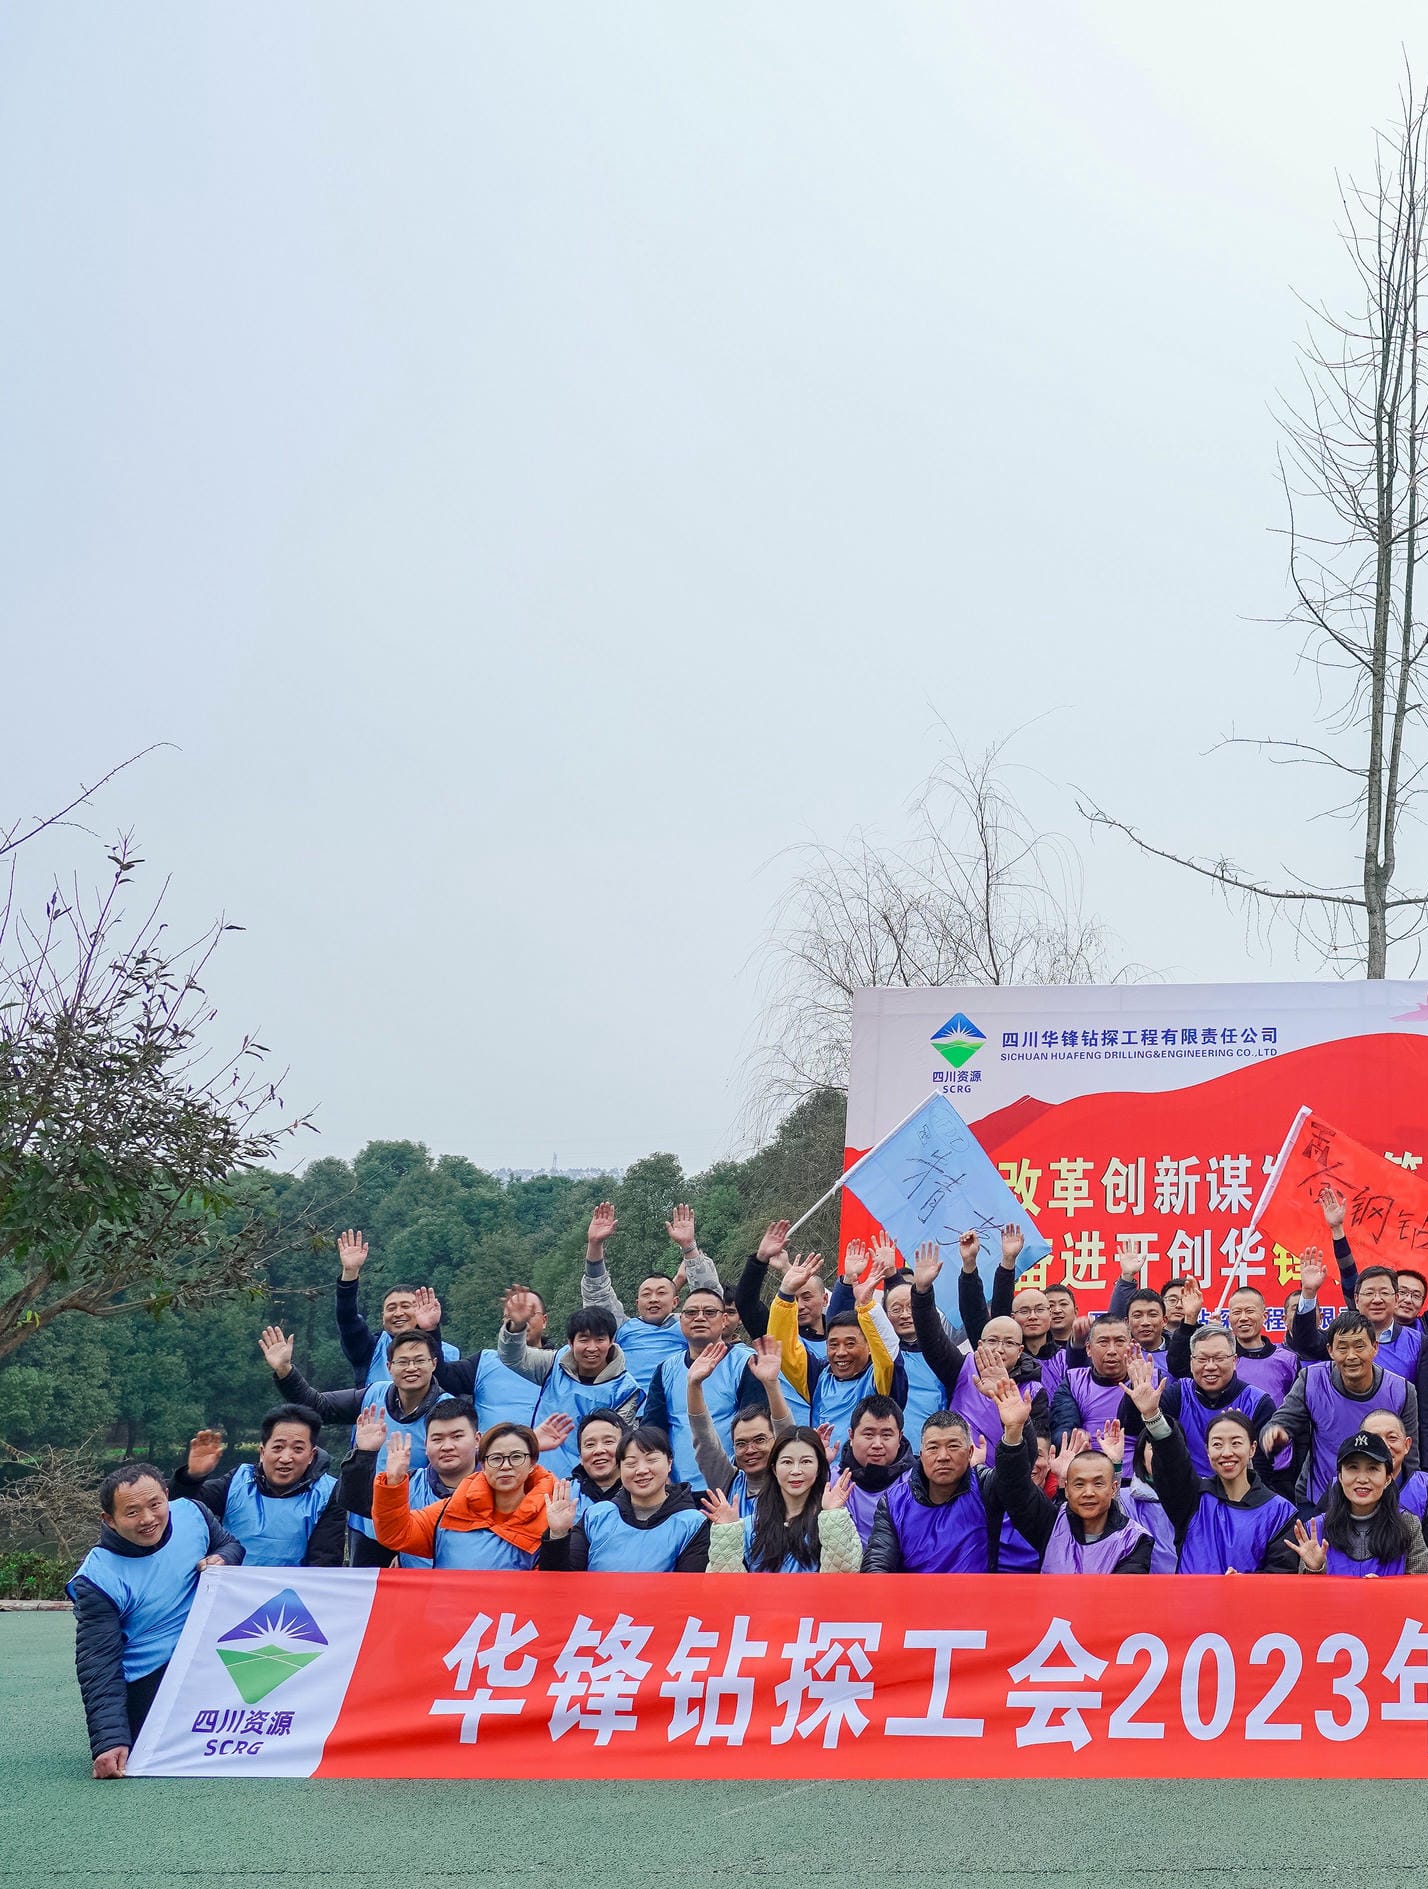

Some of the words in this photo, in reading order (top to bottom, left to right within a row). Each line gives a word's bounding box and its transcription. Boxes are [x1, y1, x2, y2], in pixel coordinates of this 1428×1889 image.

[1001, 1026, 1279, 1049] 四川华锋钻探工程有限责任公司
[1000, 1051, 1049, 1062] SICHUAN
[1050, 1050, 1102, 1061] HUAFENG
[1103, 1049, 1235, 1060] DRILLING&ENGINEERING
[932, 1070, 982, 1083] 四川资源
[942, 1085, 972, 1094] SCRG
[997, 1154, 1283, 1218] 改革创新谋
[1354, 1434, 1369, 1447] NY
[191, 1708, 296, 1737] 四川资源
[203, 1739, 265, 1757] SCRG
